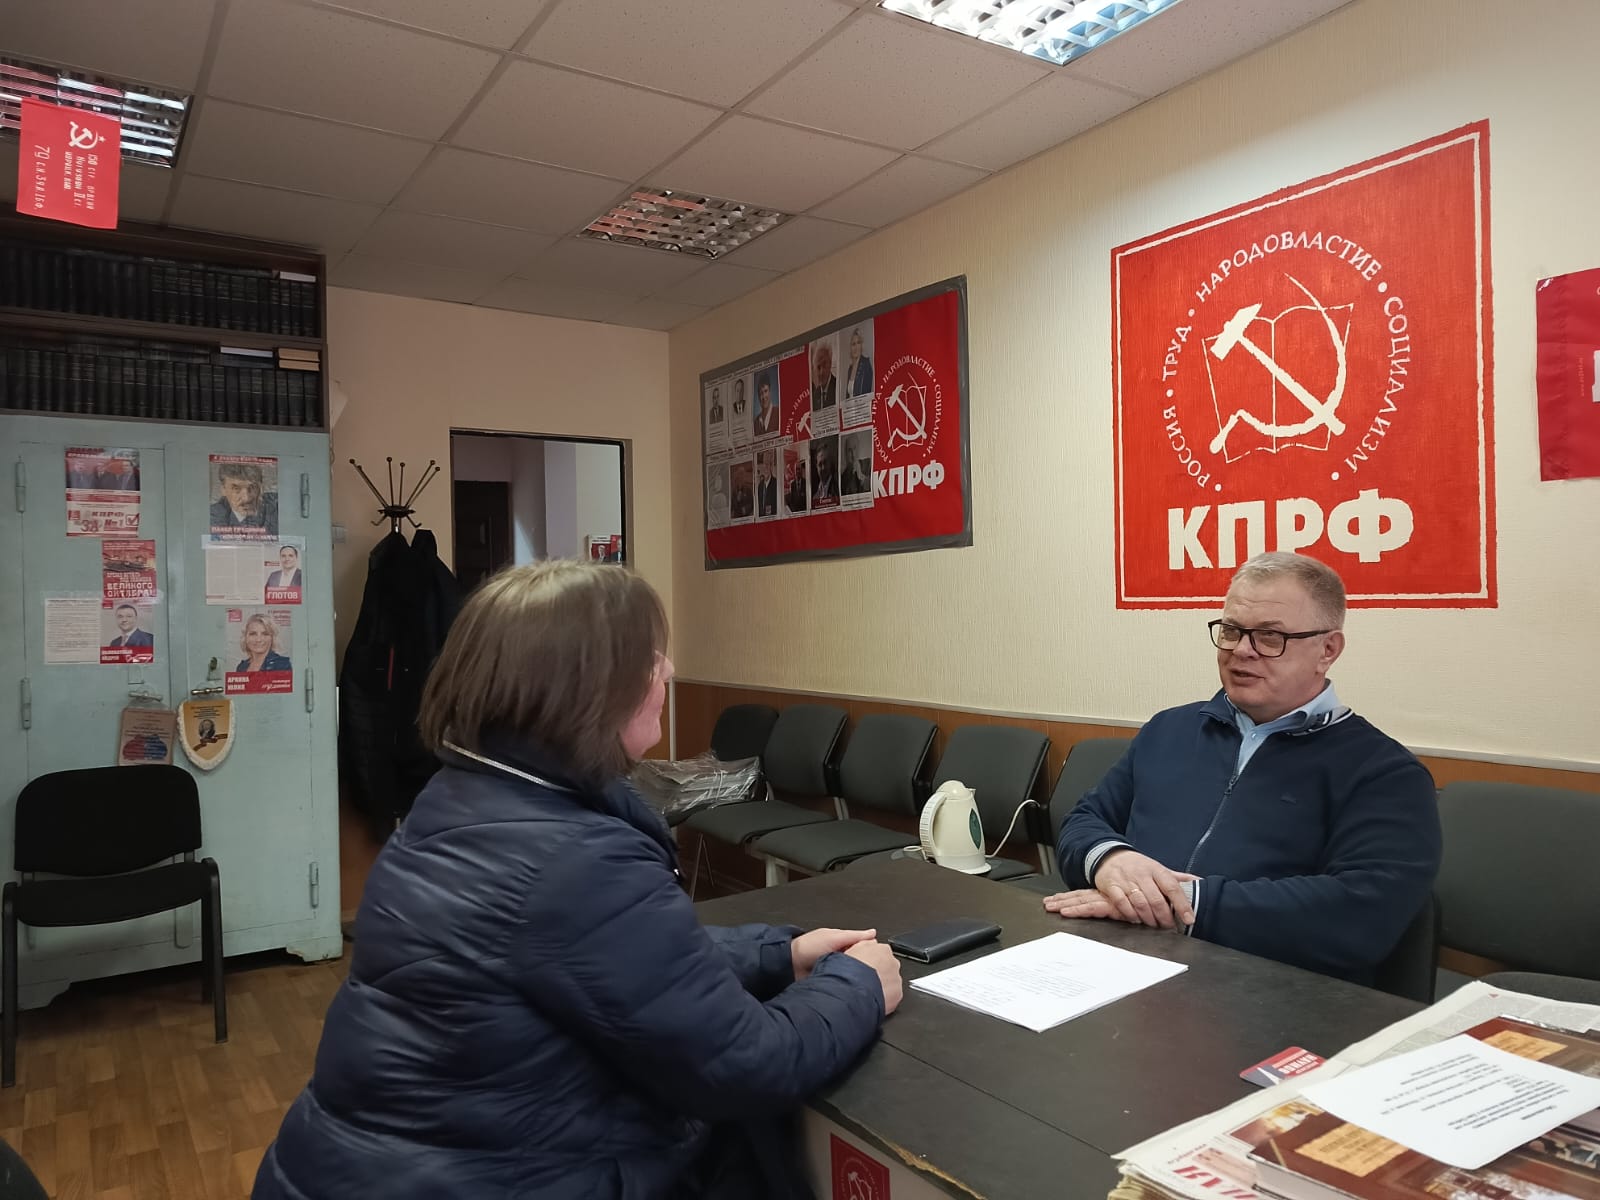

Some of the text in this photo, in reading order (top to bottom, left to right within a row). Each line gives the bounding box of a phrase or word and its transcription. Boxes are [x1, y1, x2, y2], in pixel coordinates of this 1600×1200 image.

[1195, 231, 1383, 303] НАРОДОВЛАСТИЕ
[882, 354, 935, 383] НАРОДОВЛАСТИЕ
[1162, 324, 1193, 382] ТРУД
[1344, 295, 1411, 473] СОЦИАЛИЗМ
[926, 384, 942, 455] СОЦИАЛИЗМ
[1162, 403, 1211, 488] РОССИЯ
[873, 459, 945, 499] КПРФ
[1167, 488, 1414, 570] КПРФ
